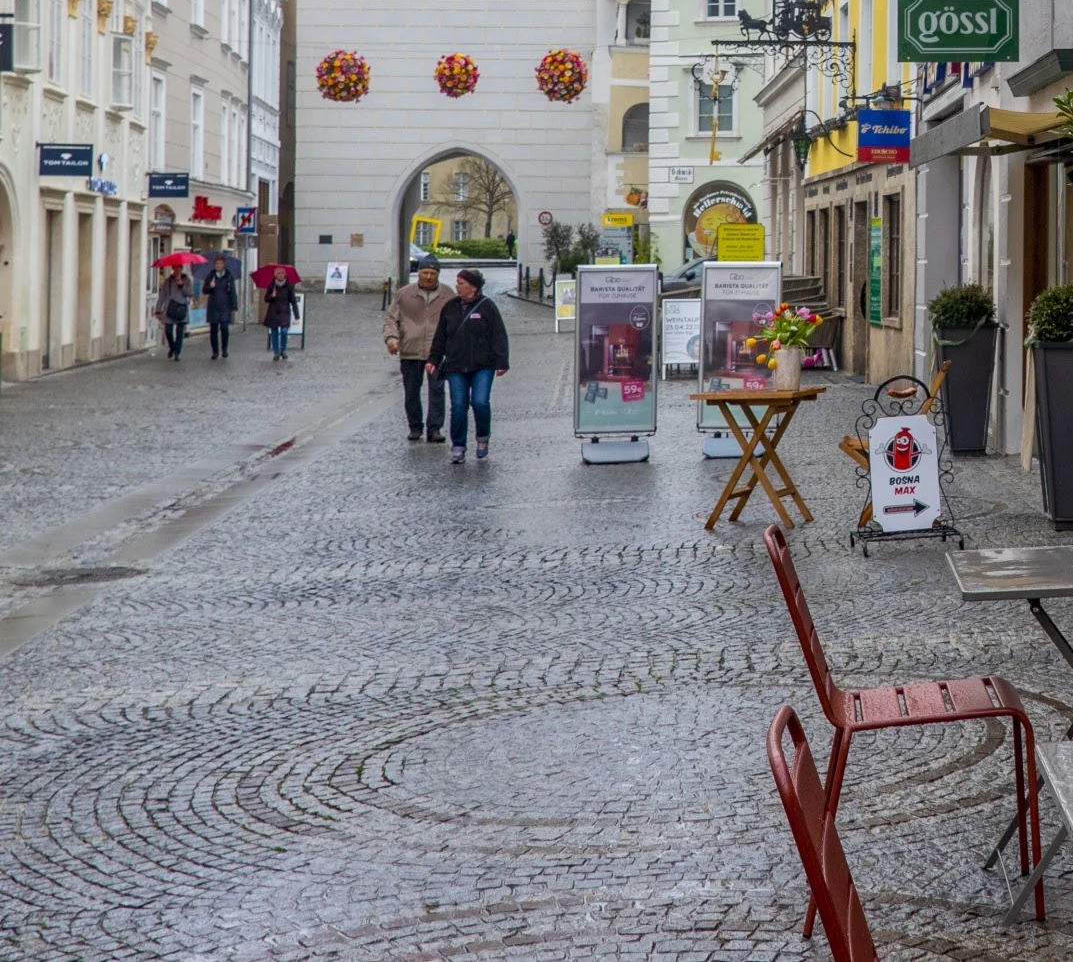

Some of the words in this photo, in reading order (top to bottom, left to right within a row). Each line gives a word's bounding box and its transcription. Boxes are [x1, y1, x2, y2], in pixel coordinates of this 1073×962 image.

[918, 6, 998, 43] gössl
[872, 124, 908, 134] Tchibo
[889, 475, 920, 485] BOSNA
[894, 486, 916, 495] MAX
